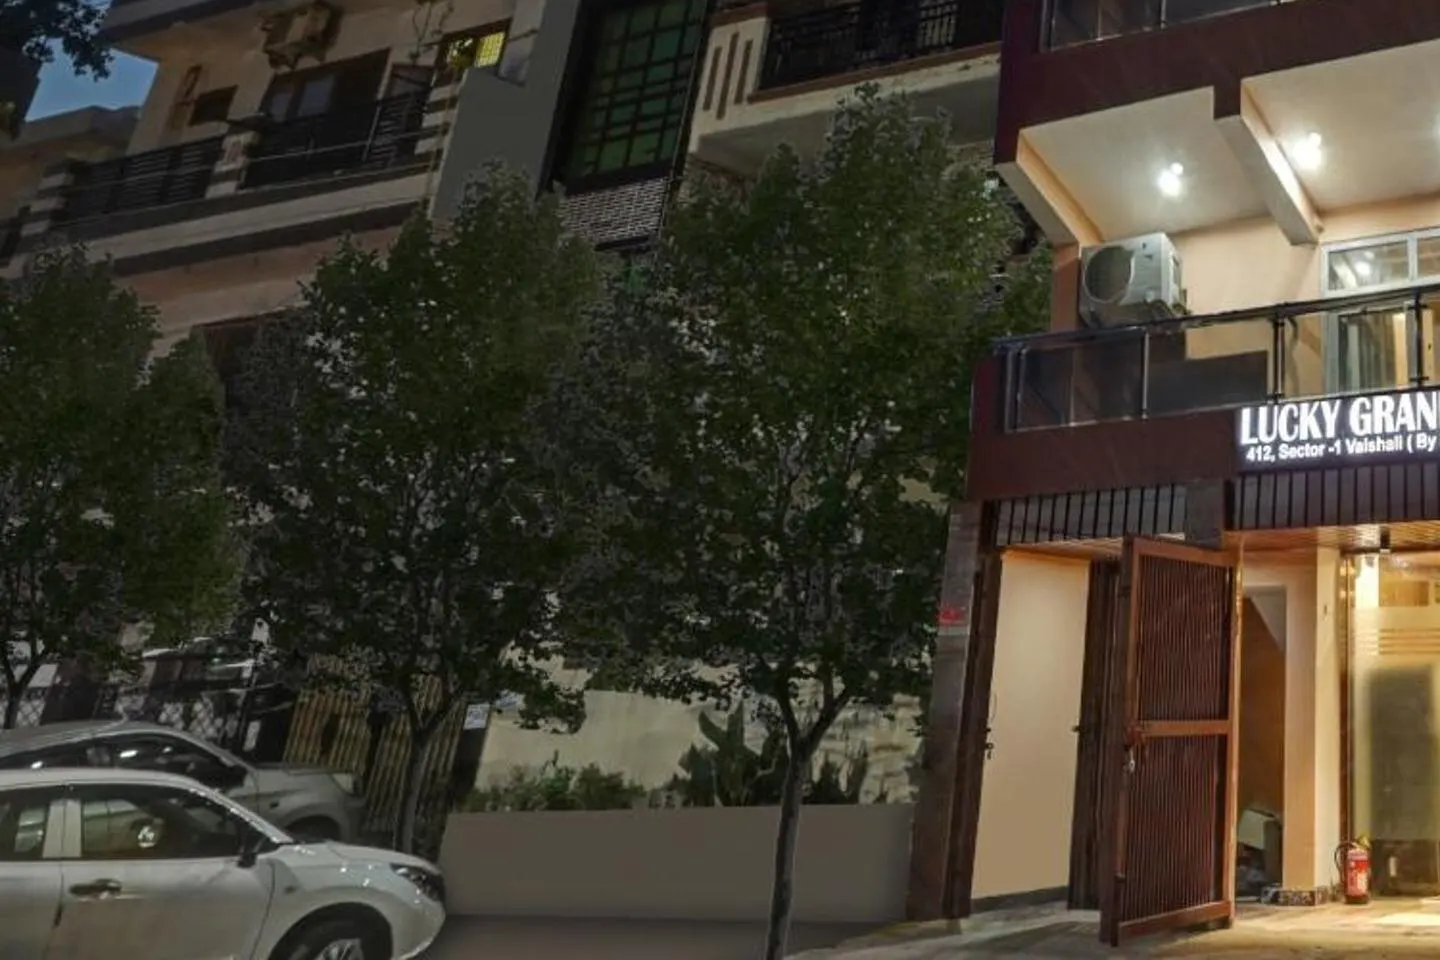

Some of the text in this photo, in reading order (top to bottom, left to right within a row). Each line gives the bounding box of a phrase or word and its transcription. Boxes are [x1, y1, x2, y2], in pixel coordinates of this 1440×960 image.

[1240, 399, 1341, 445] LUCKY
[1246, 445, 1276, 462] 412,
[1278, 443, 1325, 460] Sector
[1345, 435, 1403, 454] Vaishali
[1416, 432, 1437, 452] By
